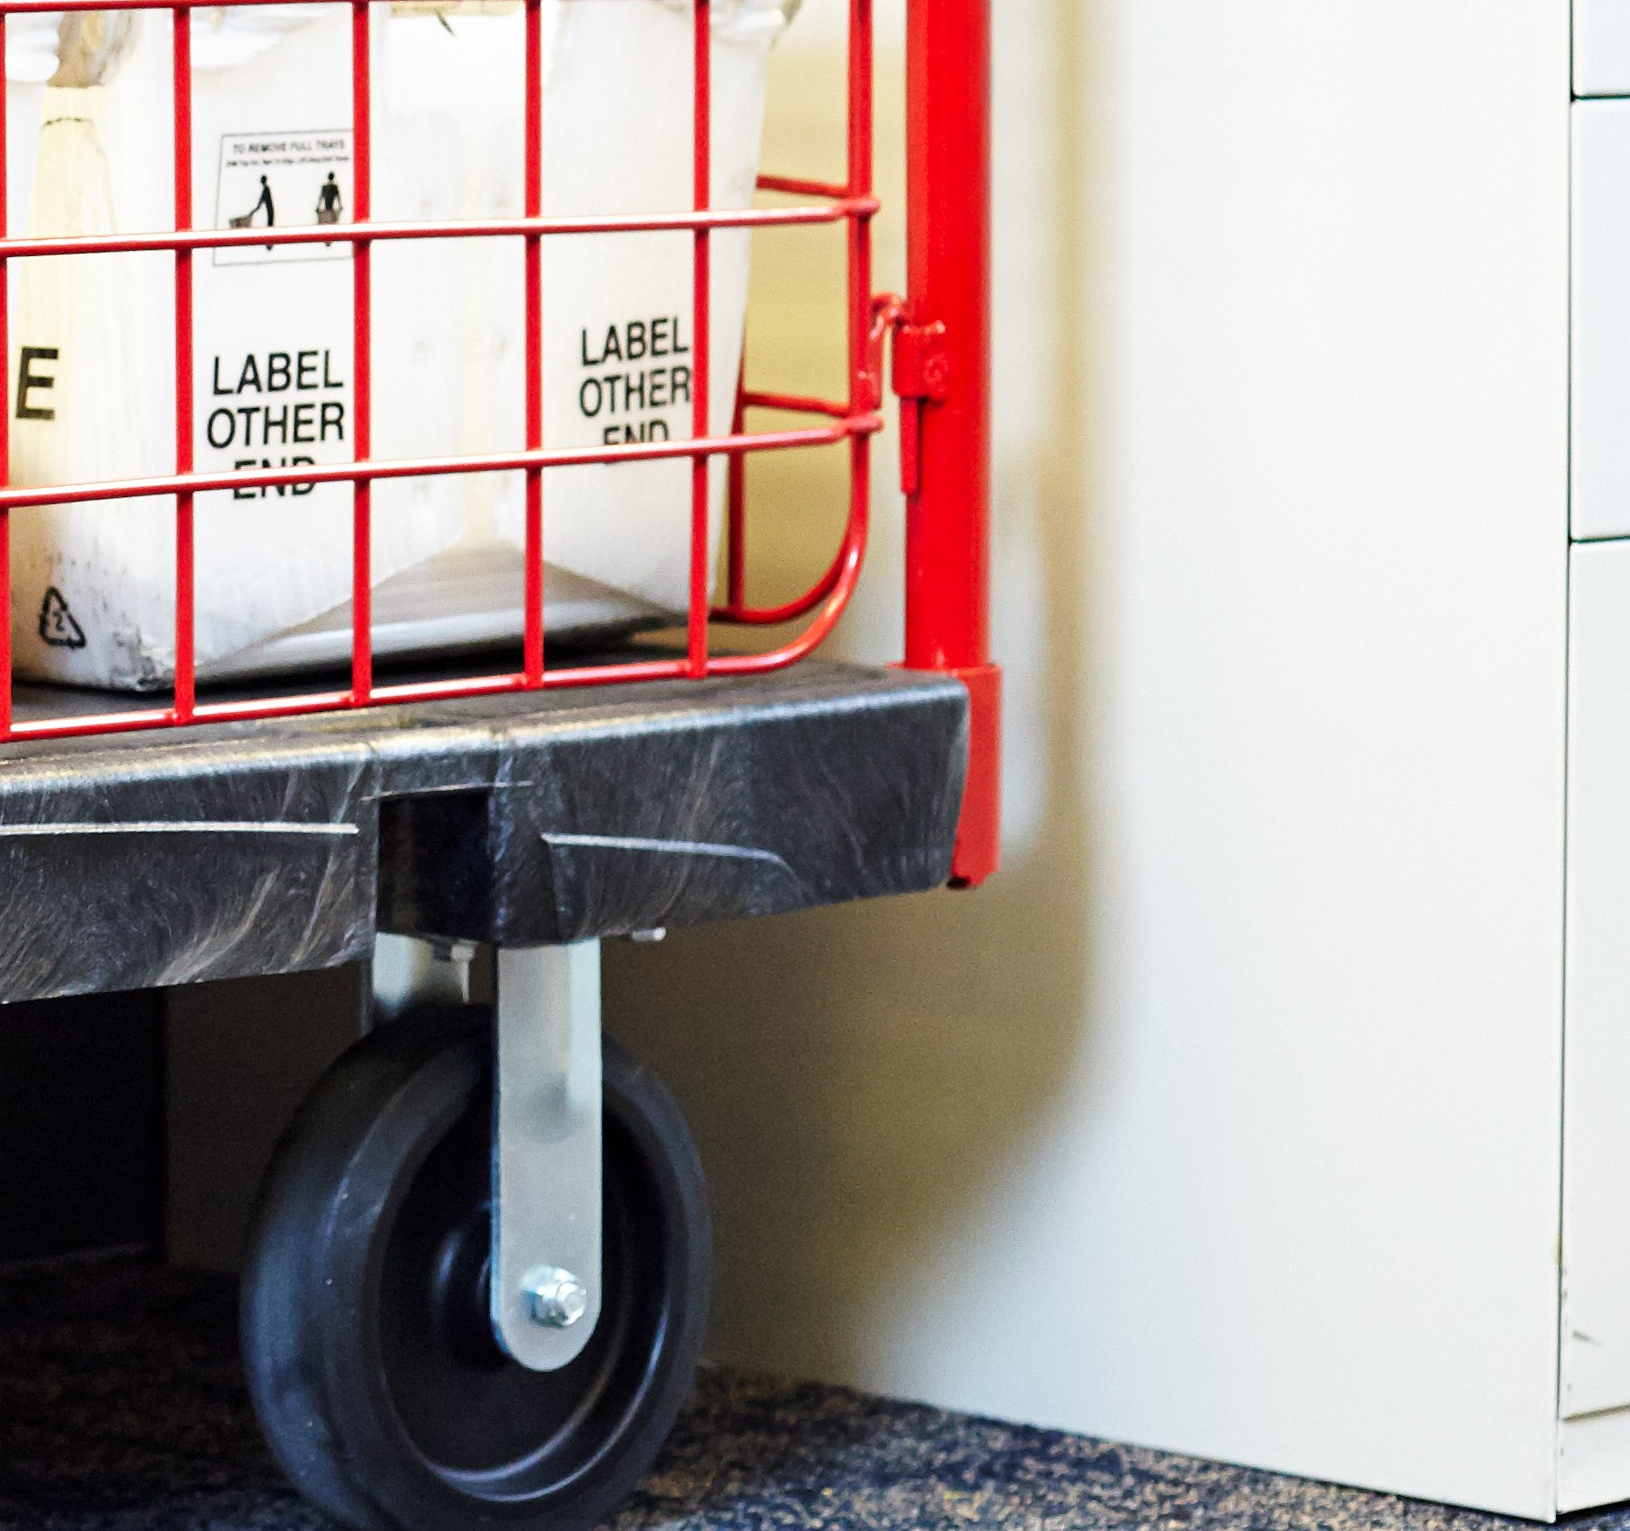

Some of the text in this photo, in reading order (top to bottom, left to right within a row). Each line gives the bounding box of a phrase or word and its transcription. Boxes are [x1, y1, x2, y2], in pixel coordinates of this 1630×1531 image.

[582, 316, 689, 366] LABEL
[213, 350, 344, 395] LABEL
[579, 365, 691, 417] OTHER
[207, 401, 344, 449] OTHER
